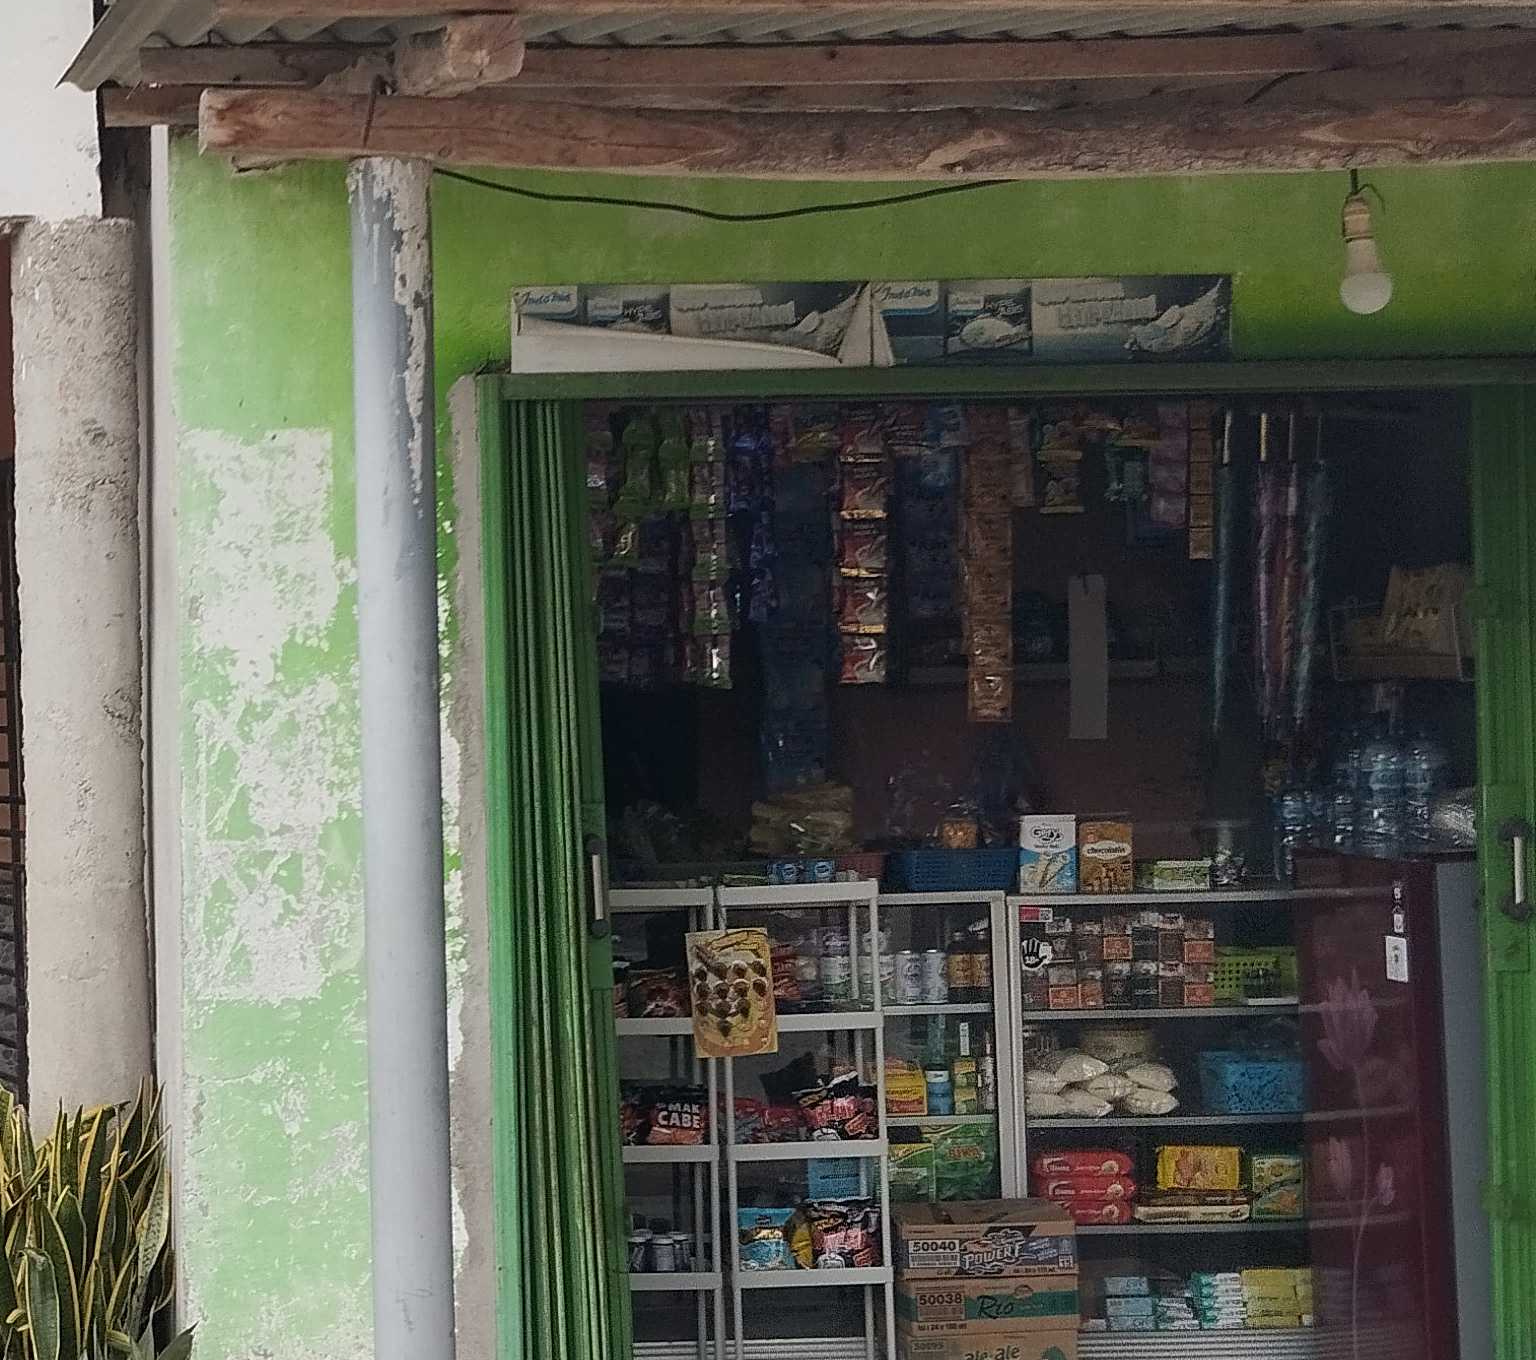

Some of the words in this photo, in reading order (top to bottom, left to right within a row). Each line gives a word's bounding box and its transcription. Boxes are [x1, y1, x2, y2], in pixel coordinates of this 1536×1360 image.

[657, 1110, 701, 1129] CABE
[912, 1241, 956, 1252] 50040
[919, 1293, 963, 1306] 50038
[976, 1295, 1014, 1319] Rio
